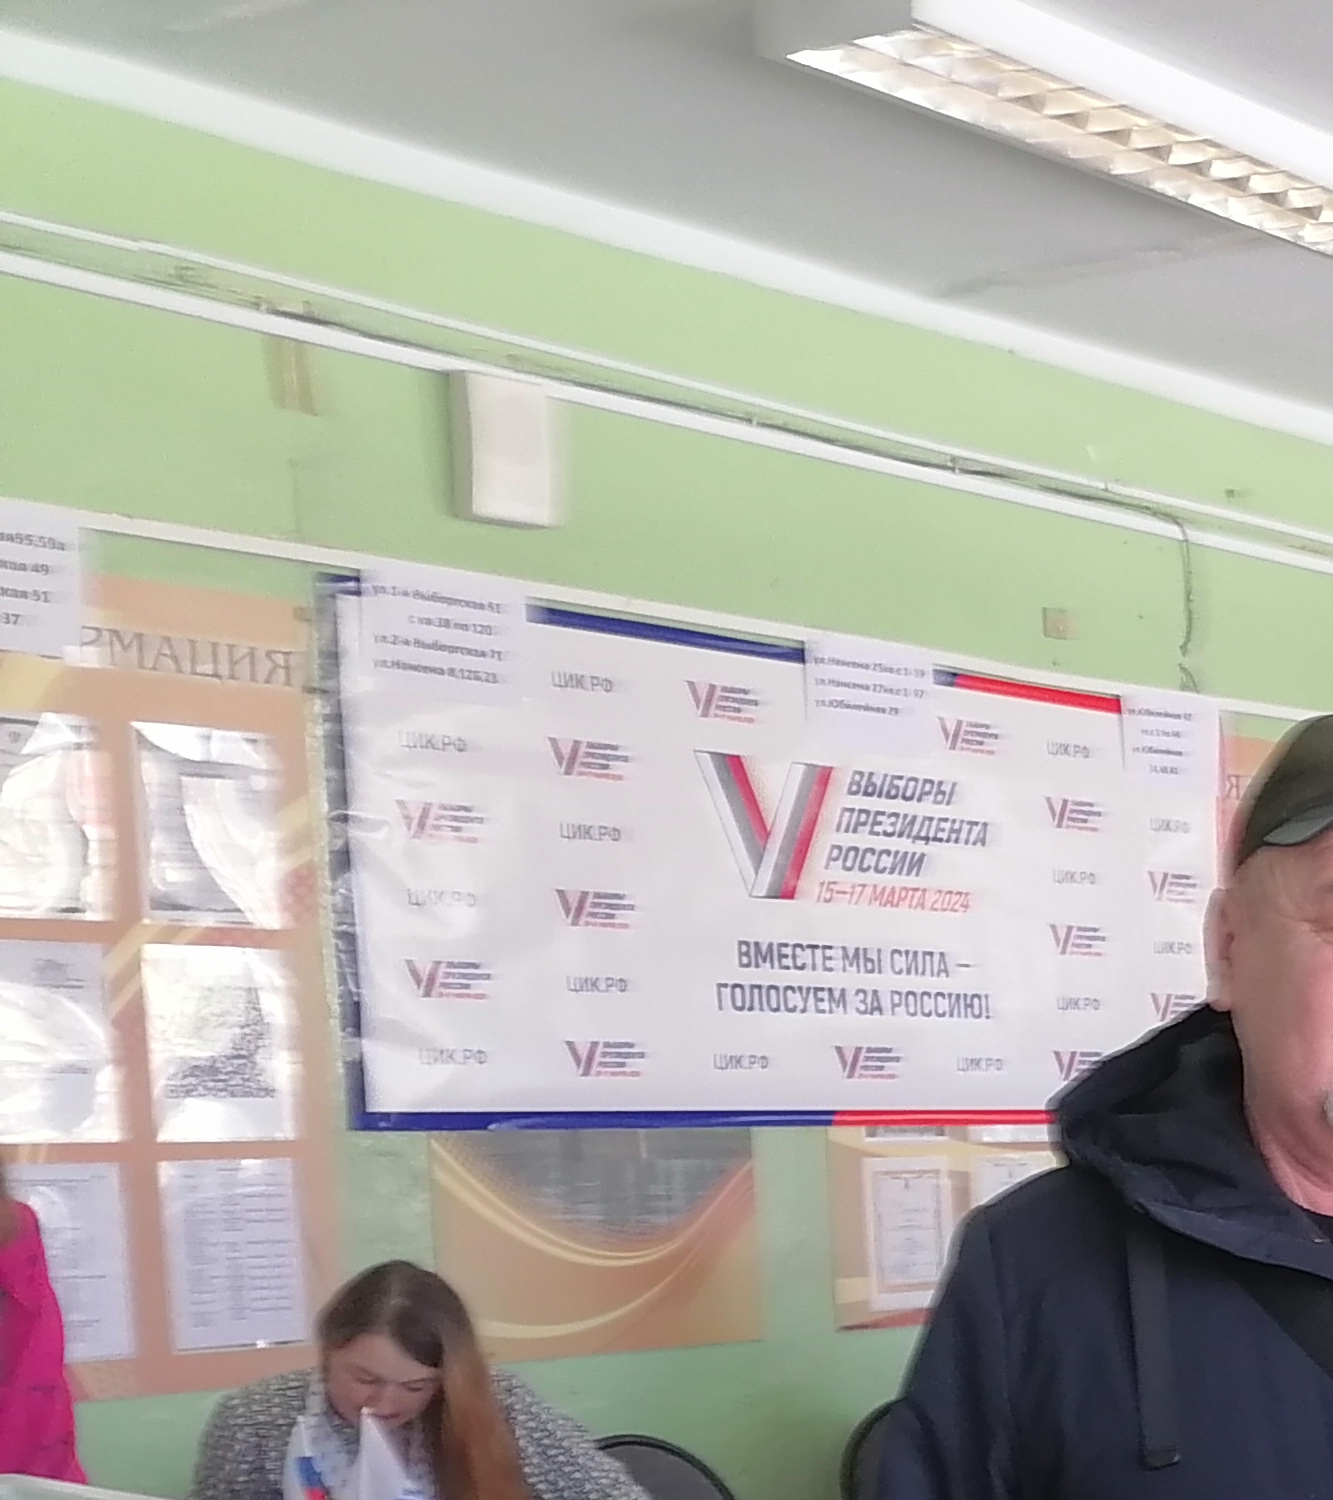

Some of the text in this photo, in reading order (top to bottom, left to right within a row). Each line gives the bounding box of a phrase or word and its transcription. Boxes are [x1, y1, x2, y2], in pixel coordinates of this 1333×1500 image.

[847, 769, 958, 806] ВЫБОРЫ
[835, 806, 989, 847] ПРЕЗИДЕНТА
[824, 843, 927, 877] РОССИИ
[870, 884, 928, 911] МАРТА
[930, 889, 971, 913] 2024
[737, 939, 834, 973] ВМЕСТЕ
[841, 946, 882, 975] МЫ
[890, 948, 950, 978] СИЛА
[716, 982, 992, 1020] ГОЛОСУЕМ ЗА РОССИЮ!
